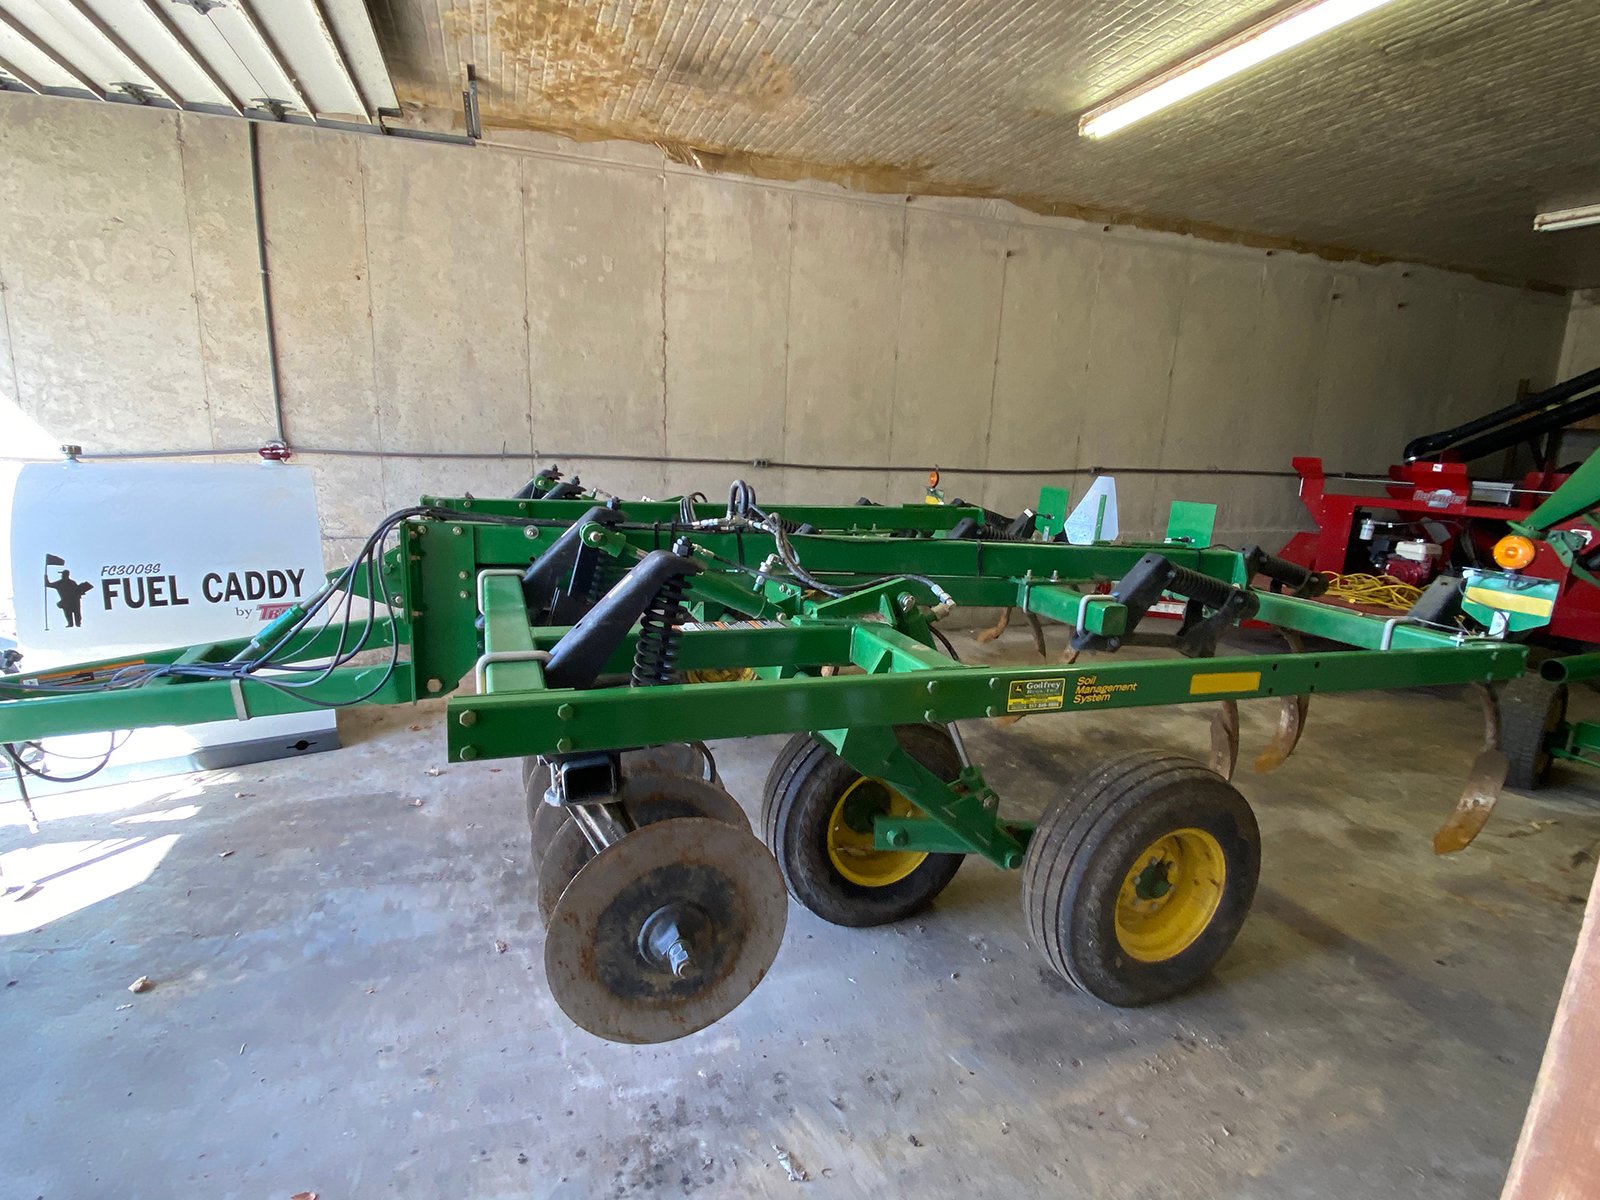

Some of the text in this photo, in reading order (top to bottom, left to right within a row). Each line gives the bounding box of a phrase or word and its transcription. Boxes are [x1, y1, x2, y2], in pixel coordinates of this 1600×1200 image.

[100, 563, 161, 576] FC300SS
[101, 568, 305, 610] FUEL CADDY
[235, 607, 252, 619] by
[1026, 682, 1061, 690] Godfrey
[1077, 676, 1097, 686] Soil
[1075, 683, 1138, 694] Management
[1073, 694, 1111, 704] System
